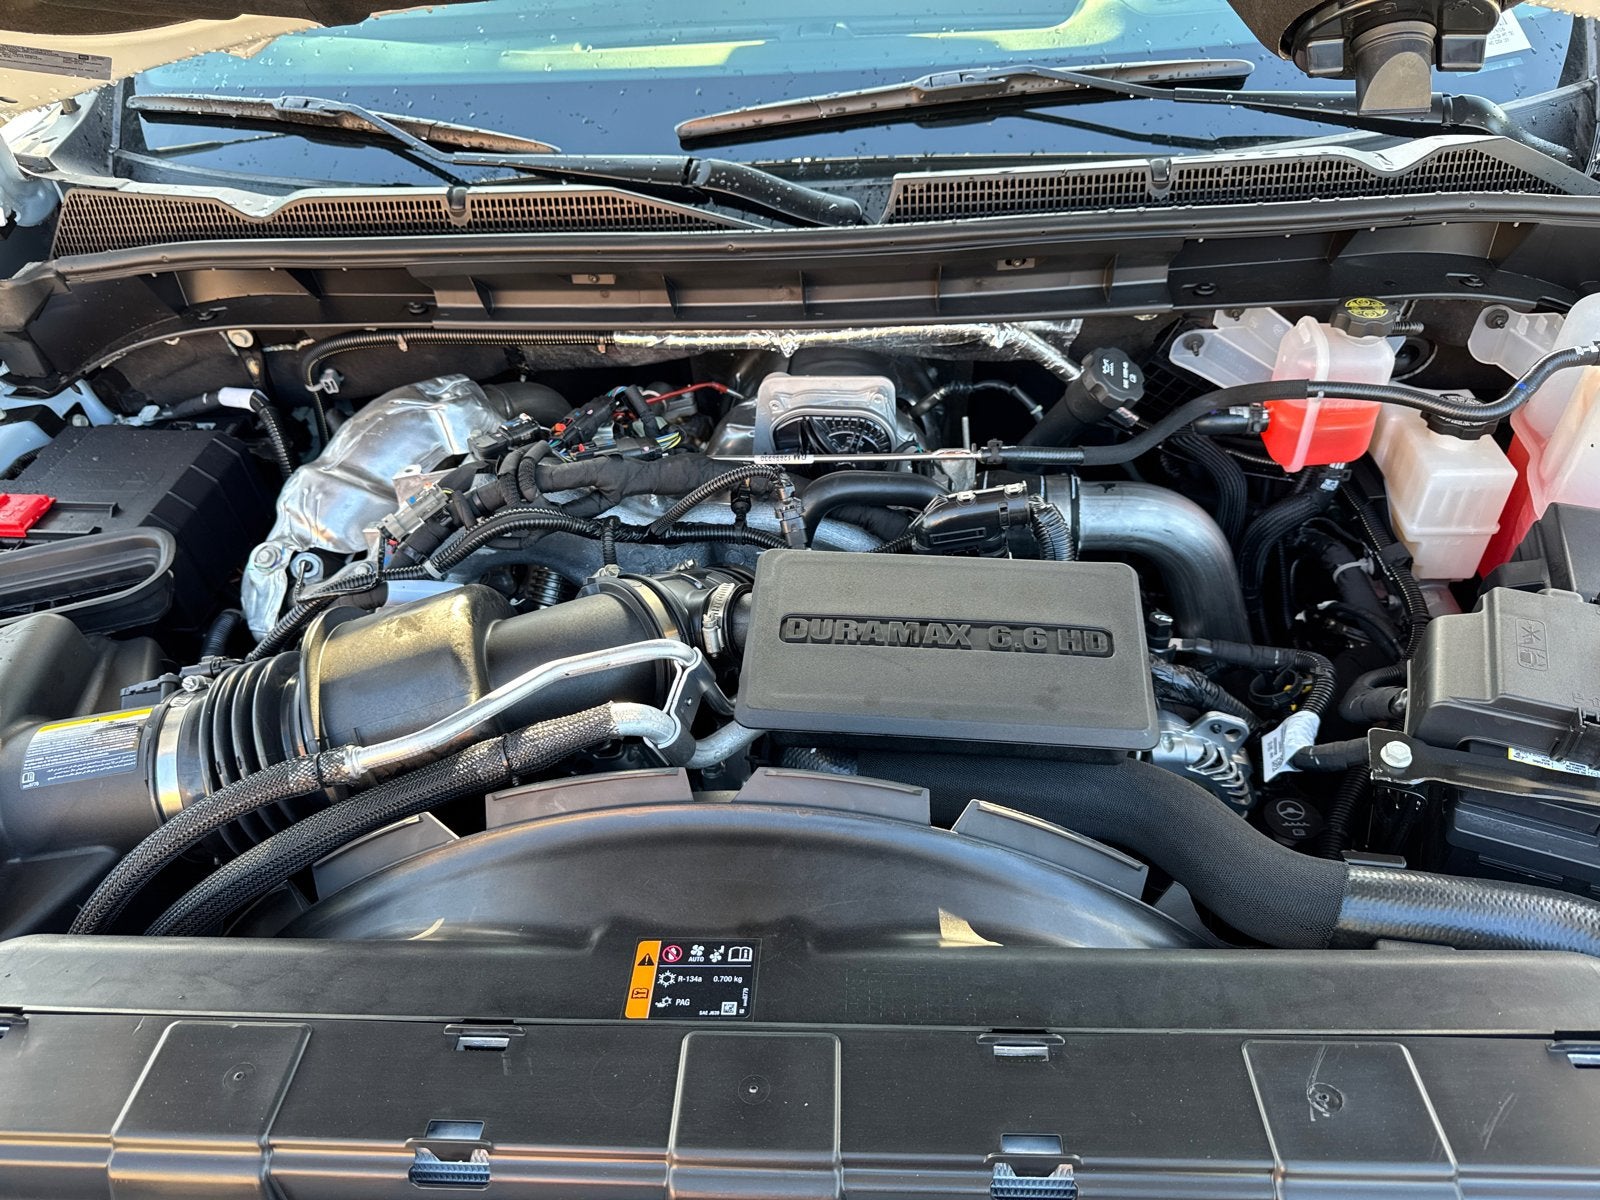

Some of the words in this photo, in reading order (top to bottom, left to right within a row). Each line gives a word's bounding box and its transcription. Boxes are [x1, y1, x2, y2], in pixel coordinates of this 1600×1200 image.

[784, 618, 972, 648] DURAMAX
[988, 625, 1048, 653] 6.6
[1056, 628, 1108, 655] HD
[677, 975, 703, 983] R-134a
[713, 975, 733, 983] 0.700
[733, 975, 743, 984] kg
[675, 998, 691, 1006] PAG
